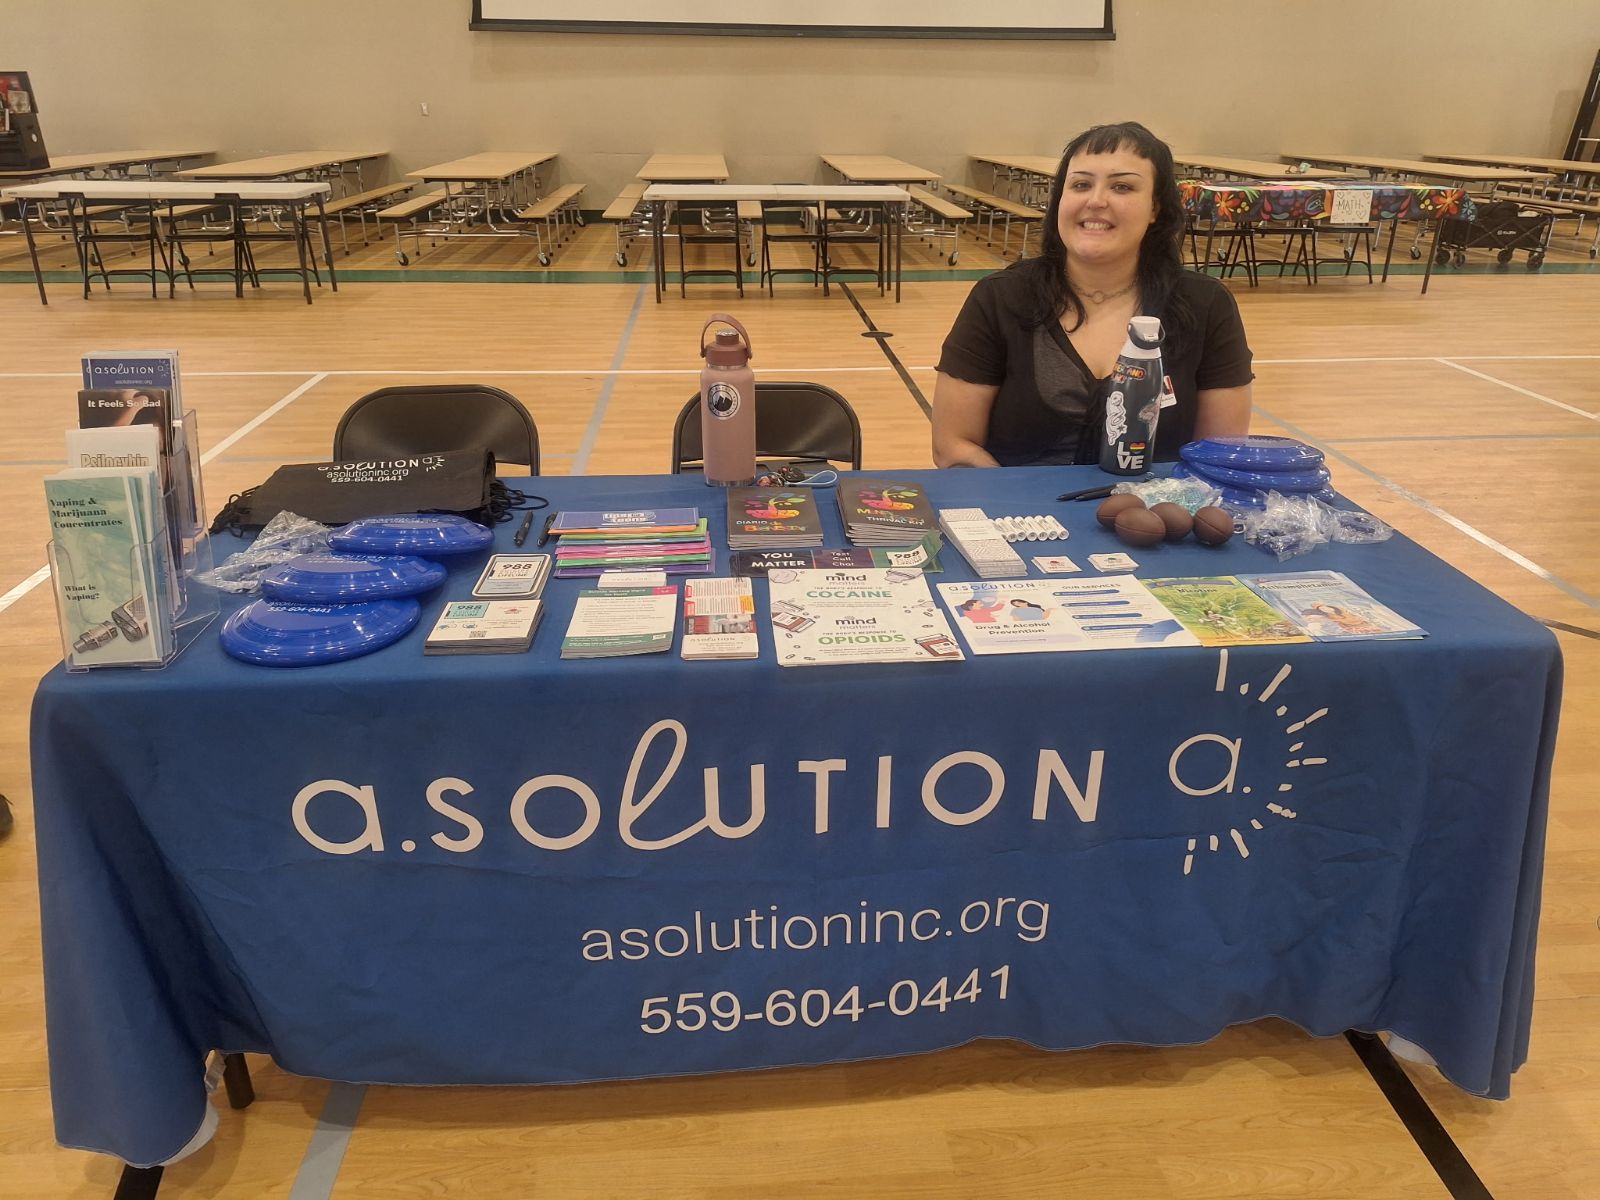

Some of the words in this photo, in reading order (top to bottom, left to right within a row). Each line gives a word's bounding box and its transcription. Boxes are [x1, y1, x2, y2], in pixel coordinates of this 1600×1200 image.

[1337, 199, 1361, 211] MATH
[88, 400, 96, 408] It
[98, 400, 124, 408] Feels
[126, 400, 139, 408] So
[142, 400, 161, 408] Bad
[326, 467, 409, 479] asolutioninc.org
[331, 475, 403, 483] 559-604-0441
[50, 498, 85, 509] Vaping
[51, 509, 107, 519] Marijuana
[53, 518, 123, 529] Concentrates
[894, 550, 920, 559] 988
[751, 560, 806, 568] MATTER
[826, 573, 867, 581] mind
[88, 583, 96, 591] is
[66, 592, 100, 602] Vaping?
[806, 590, 893, 598] COCAINE
[267, 606, 332, 614] 559-604-0441
[836, 616, 877, 625] mind
[818, 634, 907, 645] OPIOIDS
[581, 897, 1050, 962] asolutioninc.org
[640, 964, 1010, 1034] 559-604-0441
